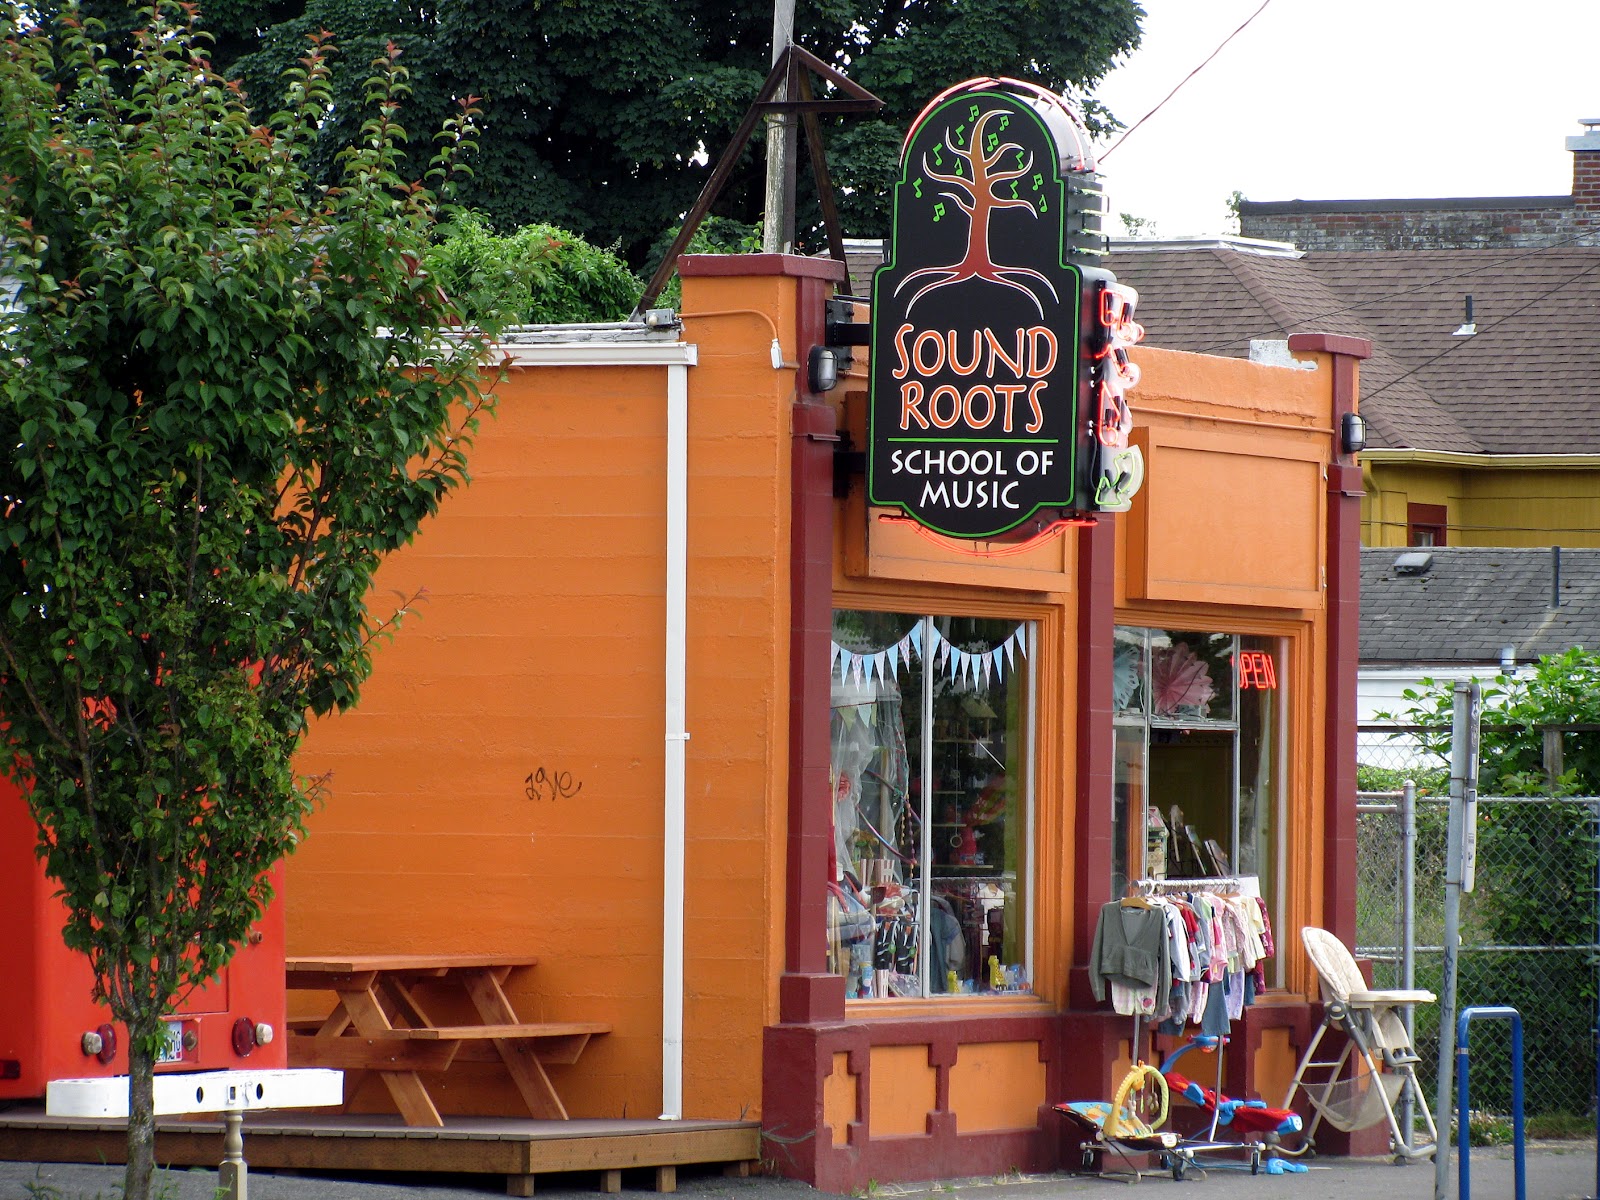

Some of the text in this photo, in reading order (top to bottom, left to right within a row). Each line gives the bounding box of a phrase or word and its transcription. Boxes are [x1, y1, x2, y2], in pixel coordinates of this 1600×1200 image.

[892, 323, 1058, 379] SOUND
[900, 380, 1049, 433] ROOTS
[891, 449, 1054, 475] SCHOOL OF
[919, 480, 1020, 509] MUSIC
